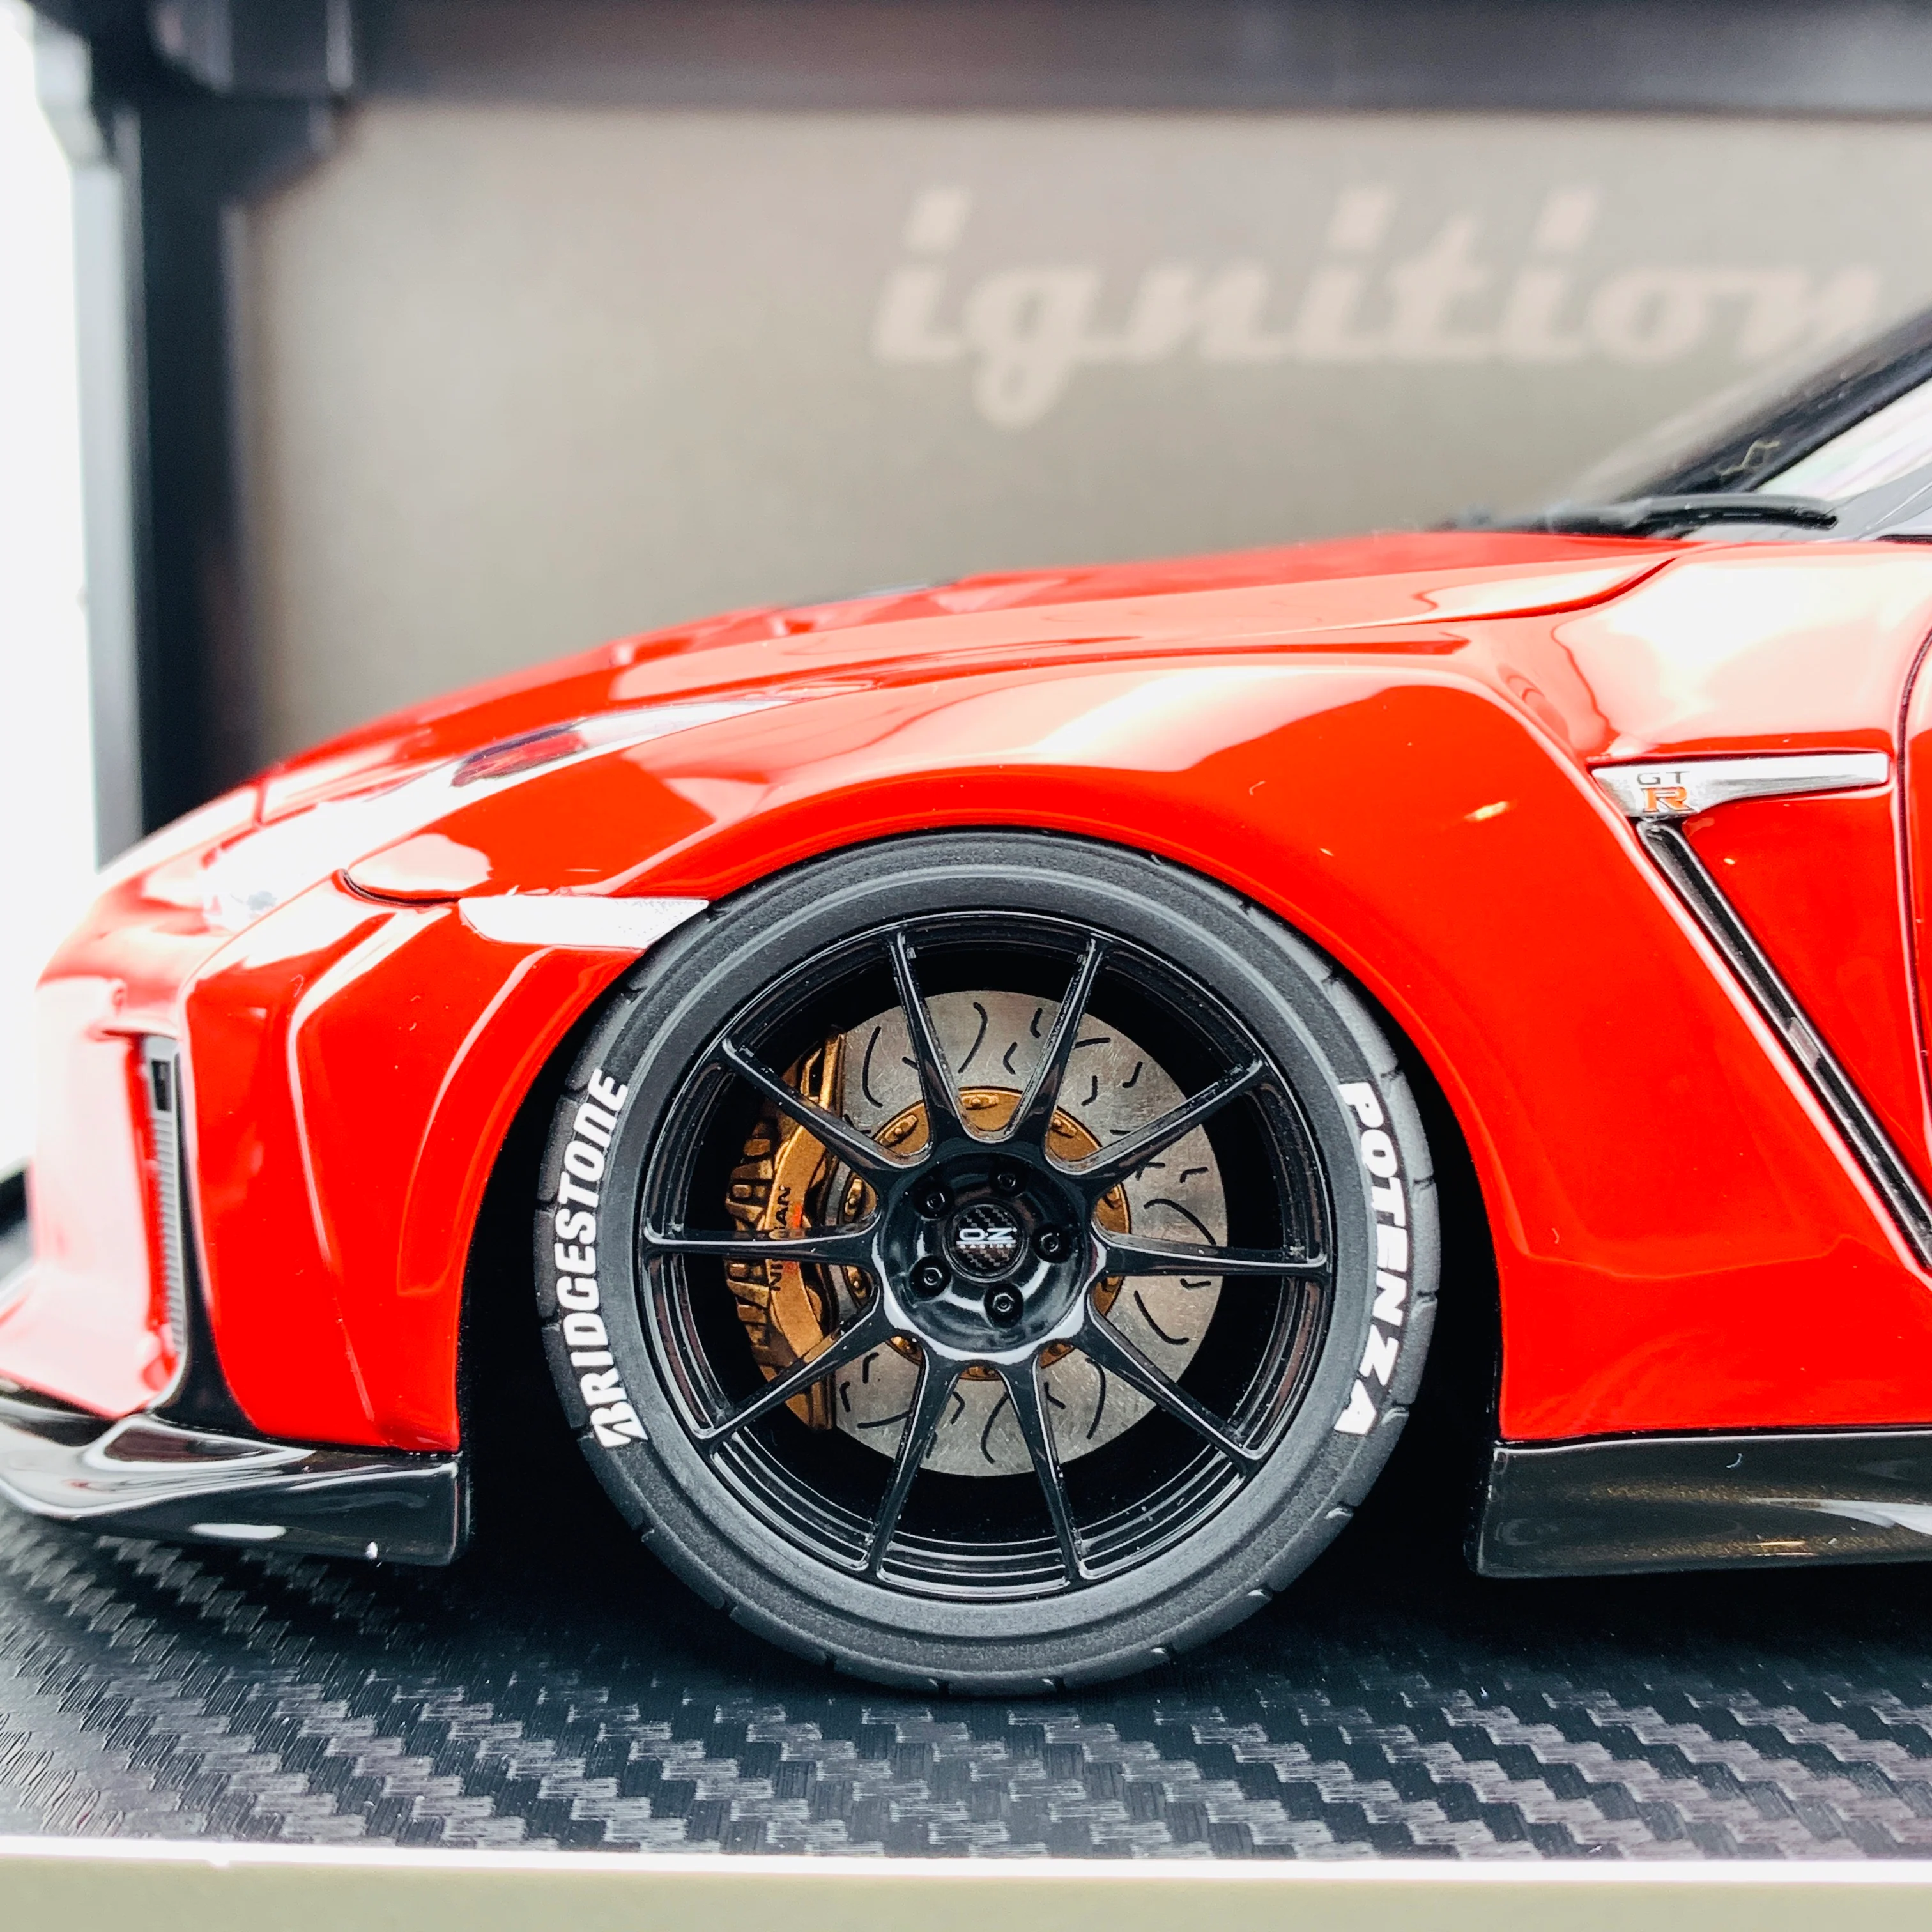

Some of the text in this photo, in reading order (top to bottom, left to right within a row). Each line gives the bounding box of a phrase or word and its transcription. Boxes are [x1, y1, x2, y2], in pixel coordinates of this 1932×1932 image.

[870, 187, 1882, 428] ignition
[1637, 771, 1690, 785] GT
[1641, 786, 1696, 813] R
[553, 1068, 648, 1448] BRIDGESTONE
[769, 1185, 792, 1292] NIAN
[1335, 1082, 1408, 1435] POTENZA
